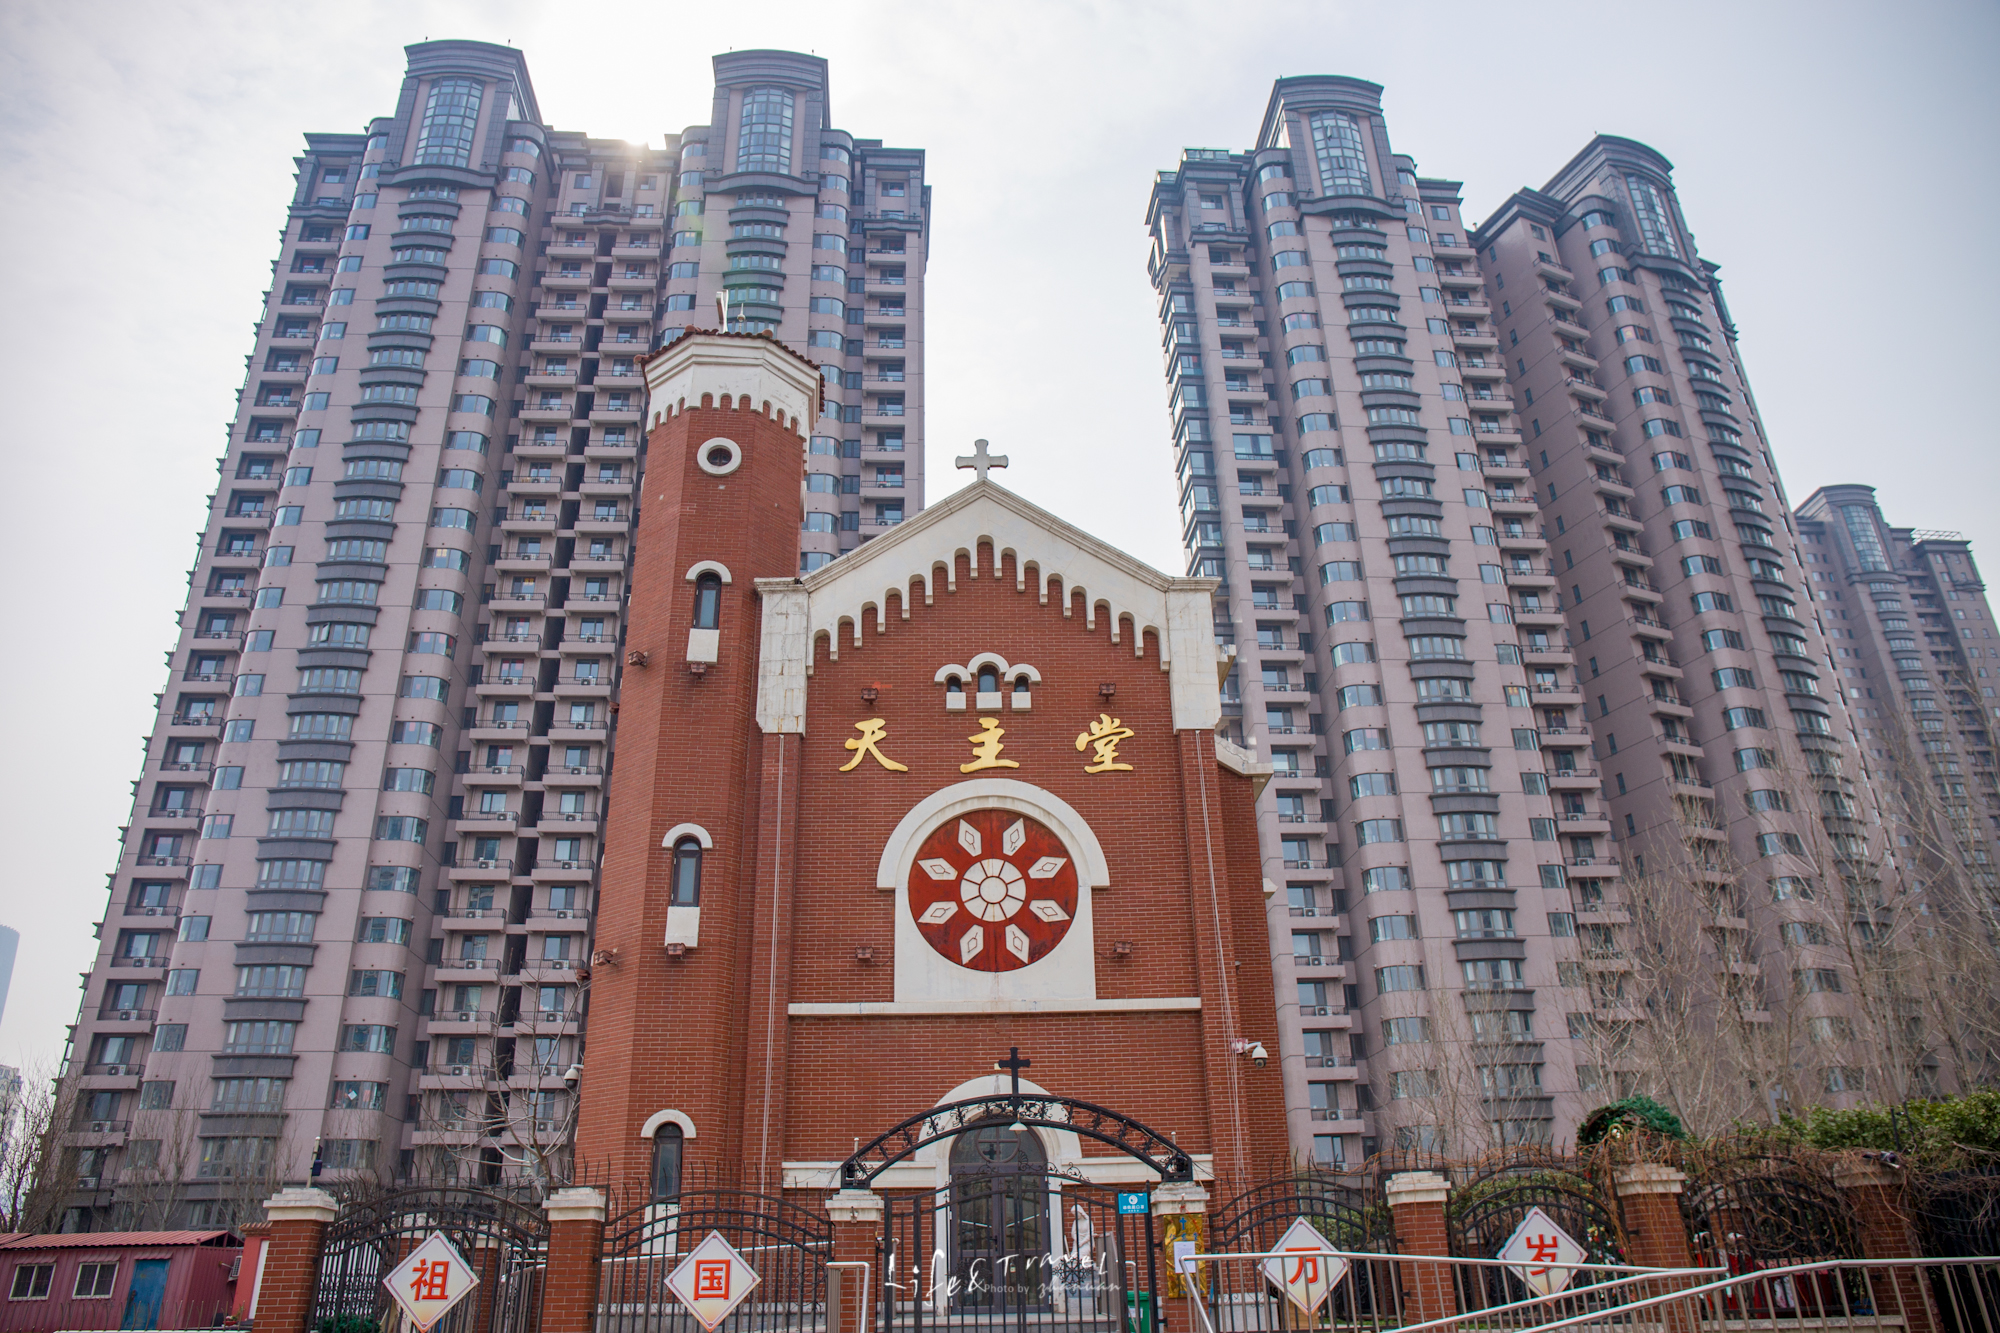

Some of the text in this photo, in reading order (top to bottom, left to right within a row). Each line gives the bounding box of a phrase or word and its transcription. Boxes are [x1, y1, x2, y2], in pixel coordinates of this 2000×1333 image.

[839, 713, 1135, 774] 天主堂
[1285, 1246, 1321, 1285] 万
[1525, 1233, 1558, 1276] 岁
[409, 1258, 450, 1302] 祖
[693, 1259, 731, 1301] 国
